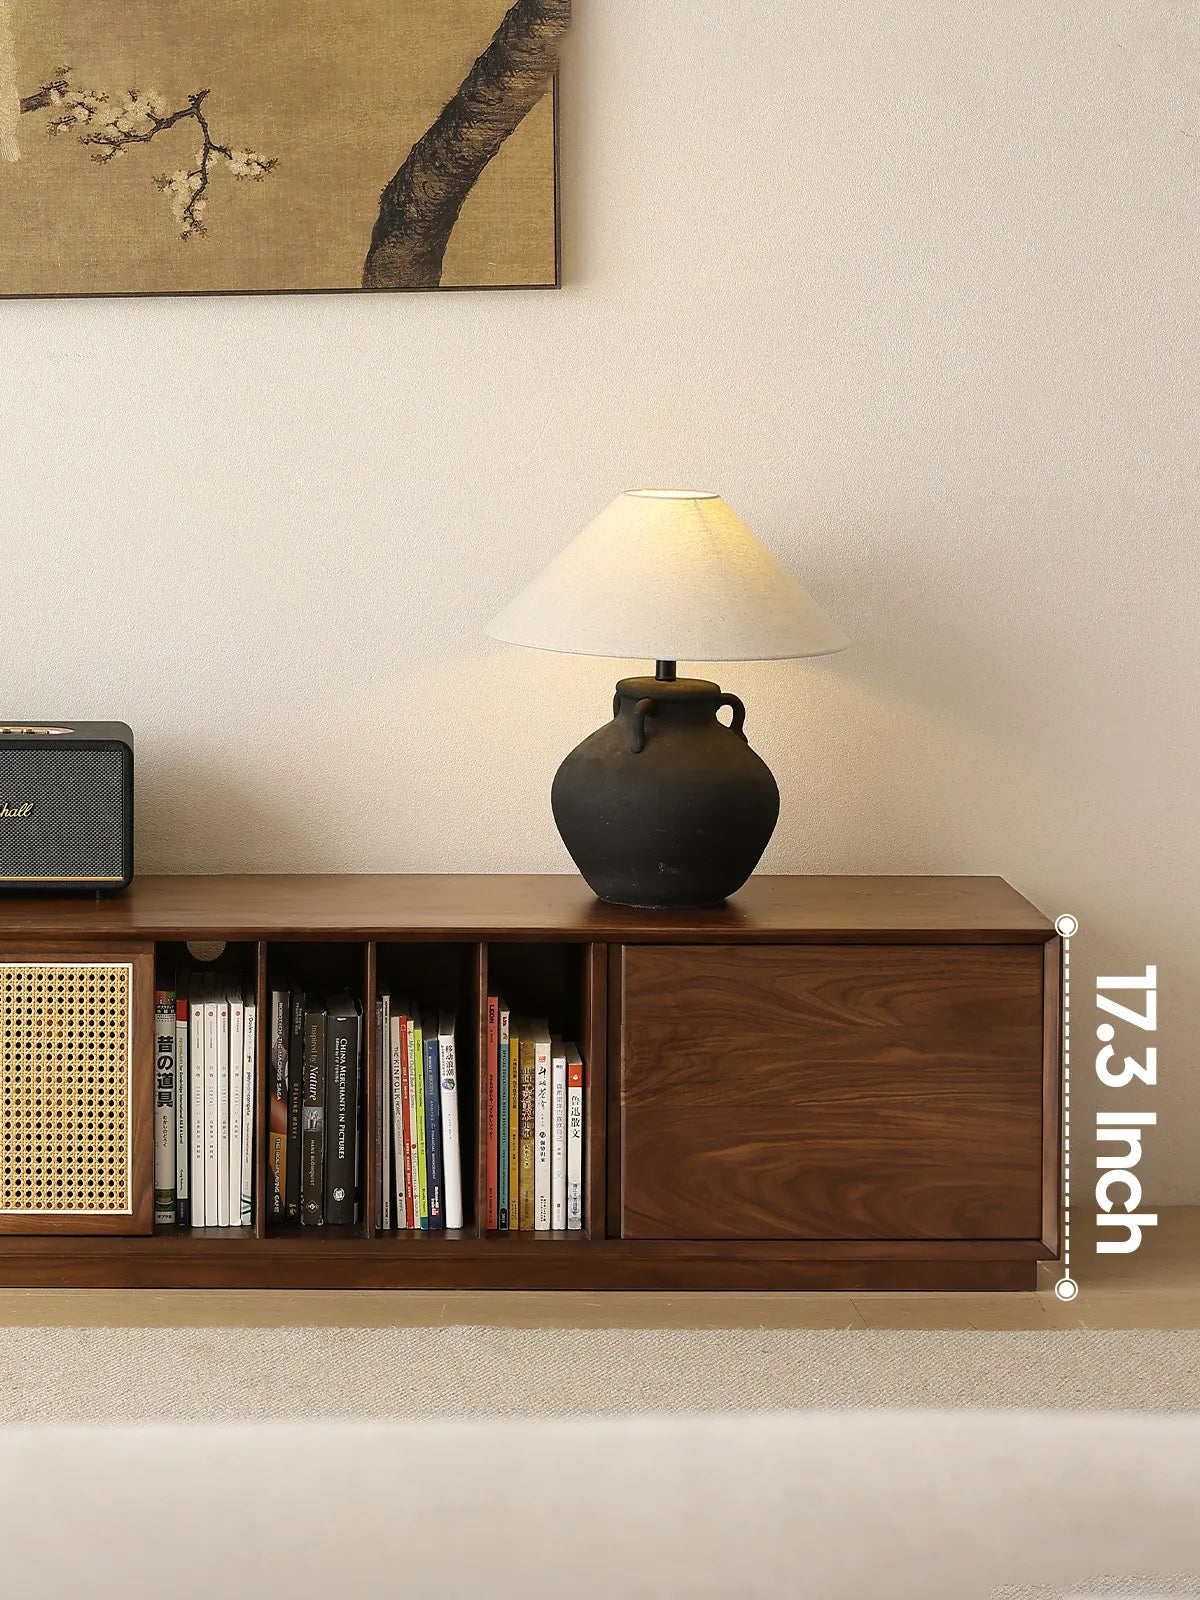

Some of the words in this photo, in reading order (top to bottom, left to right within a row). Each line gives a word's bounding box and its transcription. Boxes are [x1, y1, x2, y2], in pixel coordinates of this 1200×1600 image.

[0, 802, 34, 817] hall
[310, 1025, 318, 1053] Inspired
[157, 1035, 173, 1107] 昔の道具
[309, 1054, 317, 1063] by
[309, 1065, 319, 1101] Nature
[339, 1065, 347, 1111] MERCHANTS
[339, 1113, 345, 1122] IN
[571, 1095, 580, 1139] 鲁迅散文
